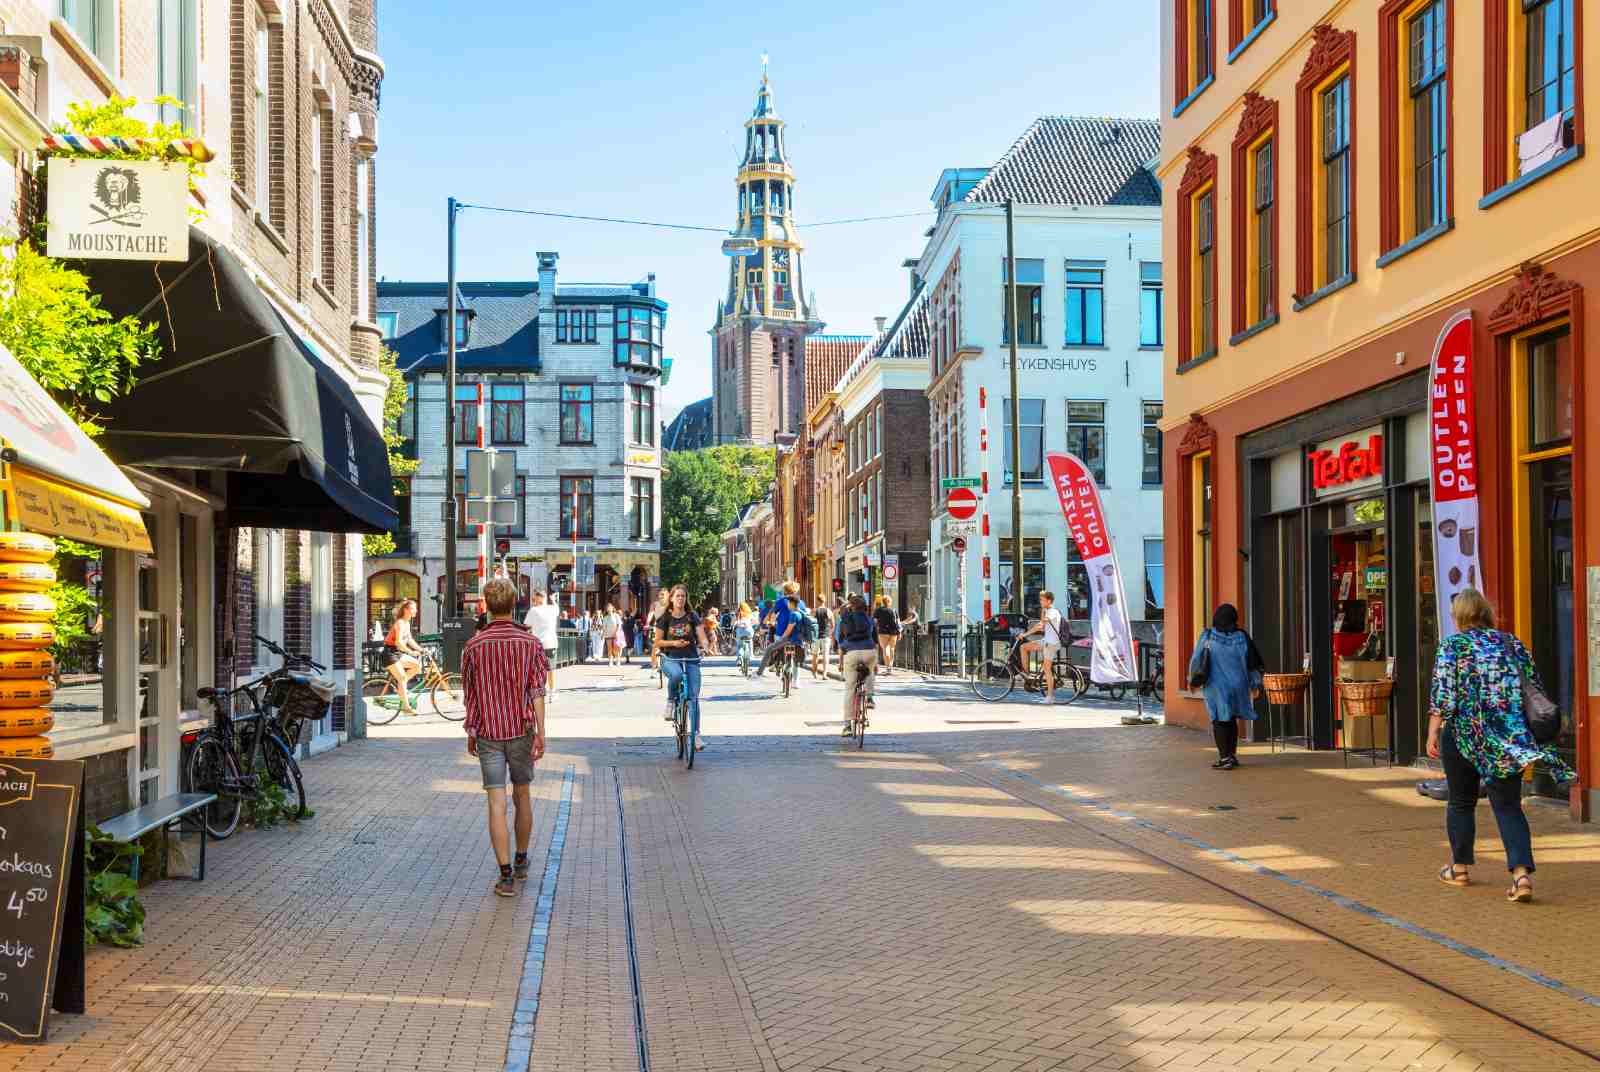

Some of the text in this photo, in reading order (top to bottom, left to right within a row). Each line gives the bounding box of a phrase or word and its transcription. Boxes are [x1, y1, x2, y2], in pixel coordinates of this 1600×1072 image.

[68, 233, 168, 253] MOUSTACHE
[1434, 363, 1455, 488] OUTLET
[1307, 434, 1383, 489] Tefal
[1367, 571, 1387, 583] OPE
